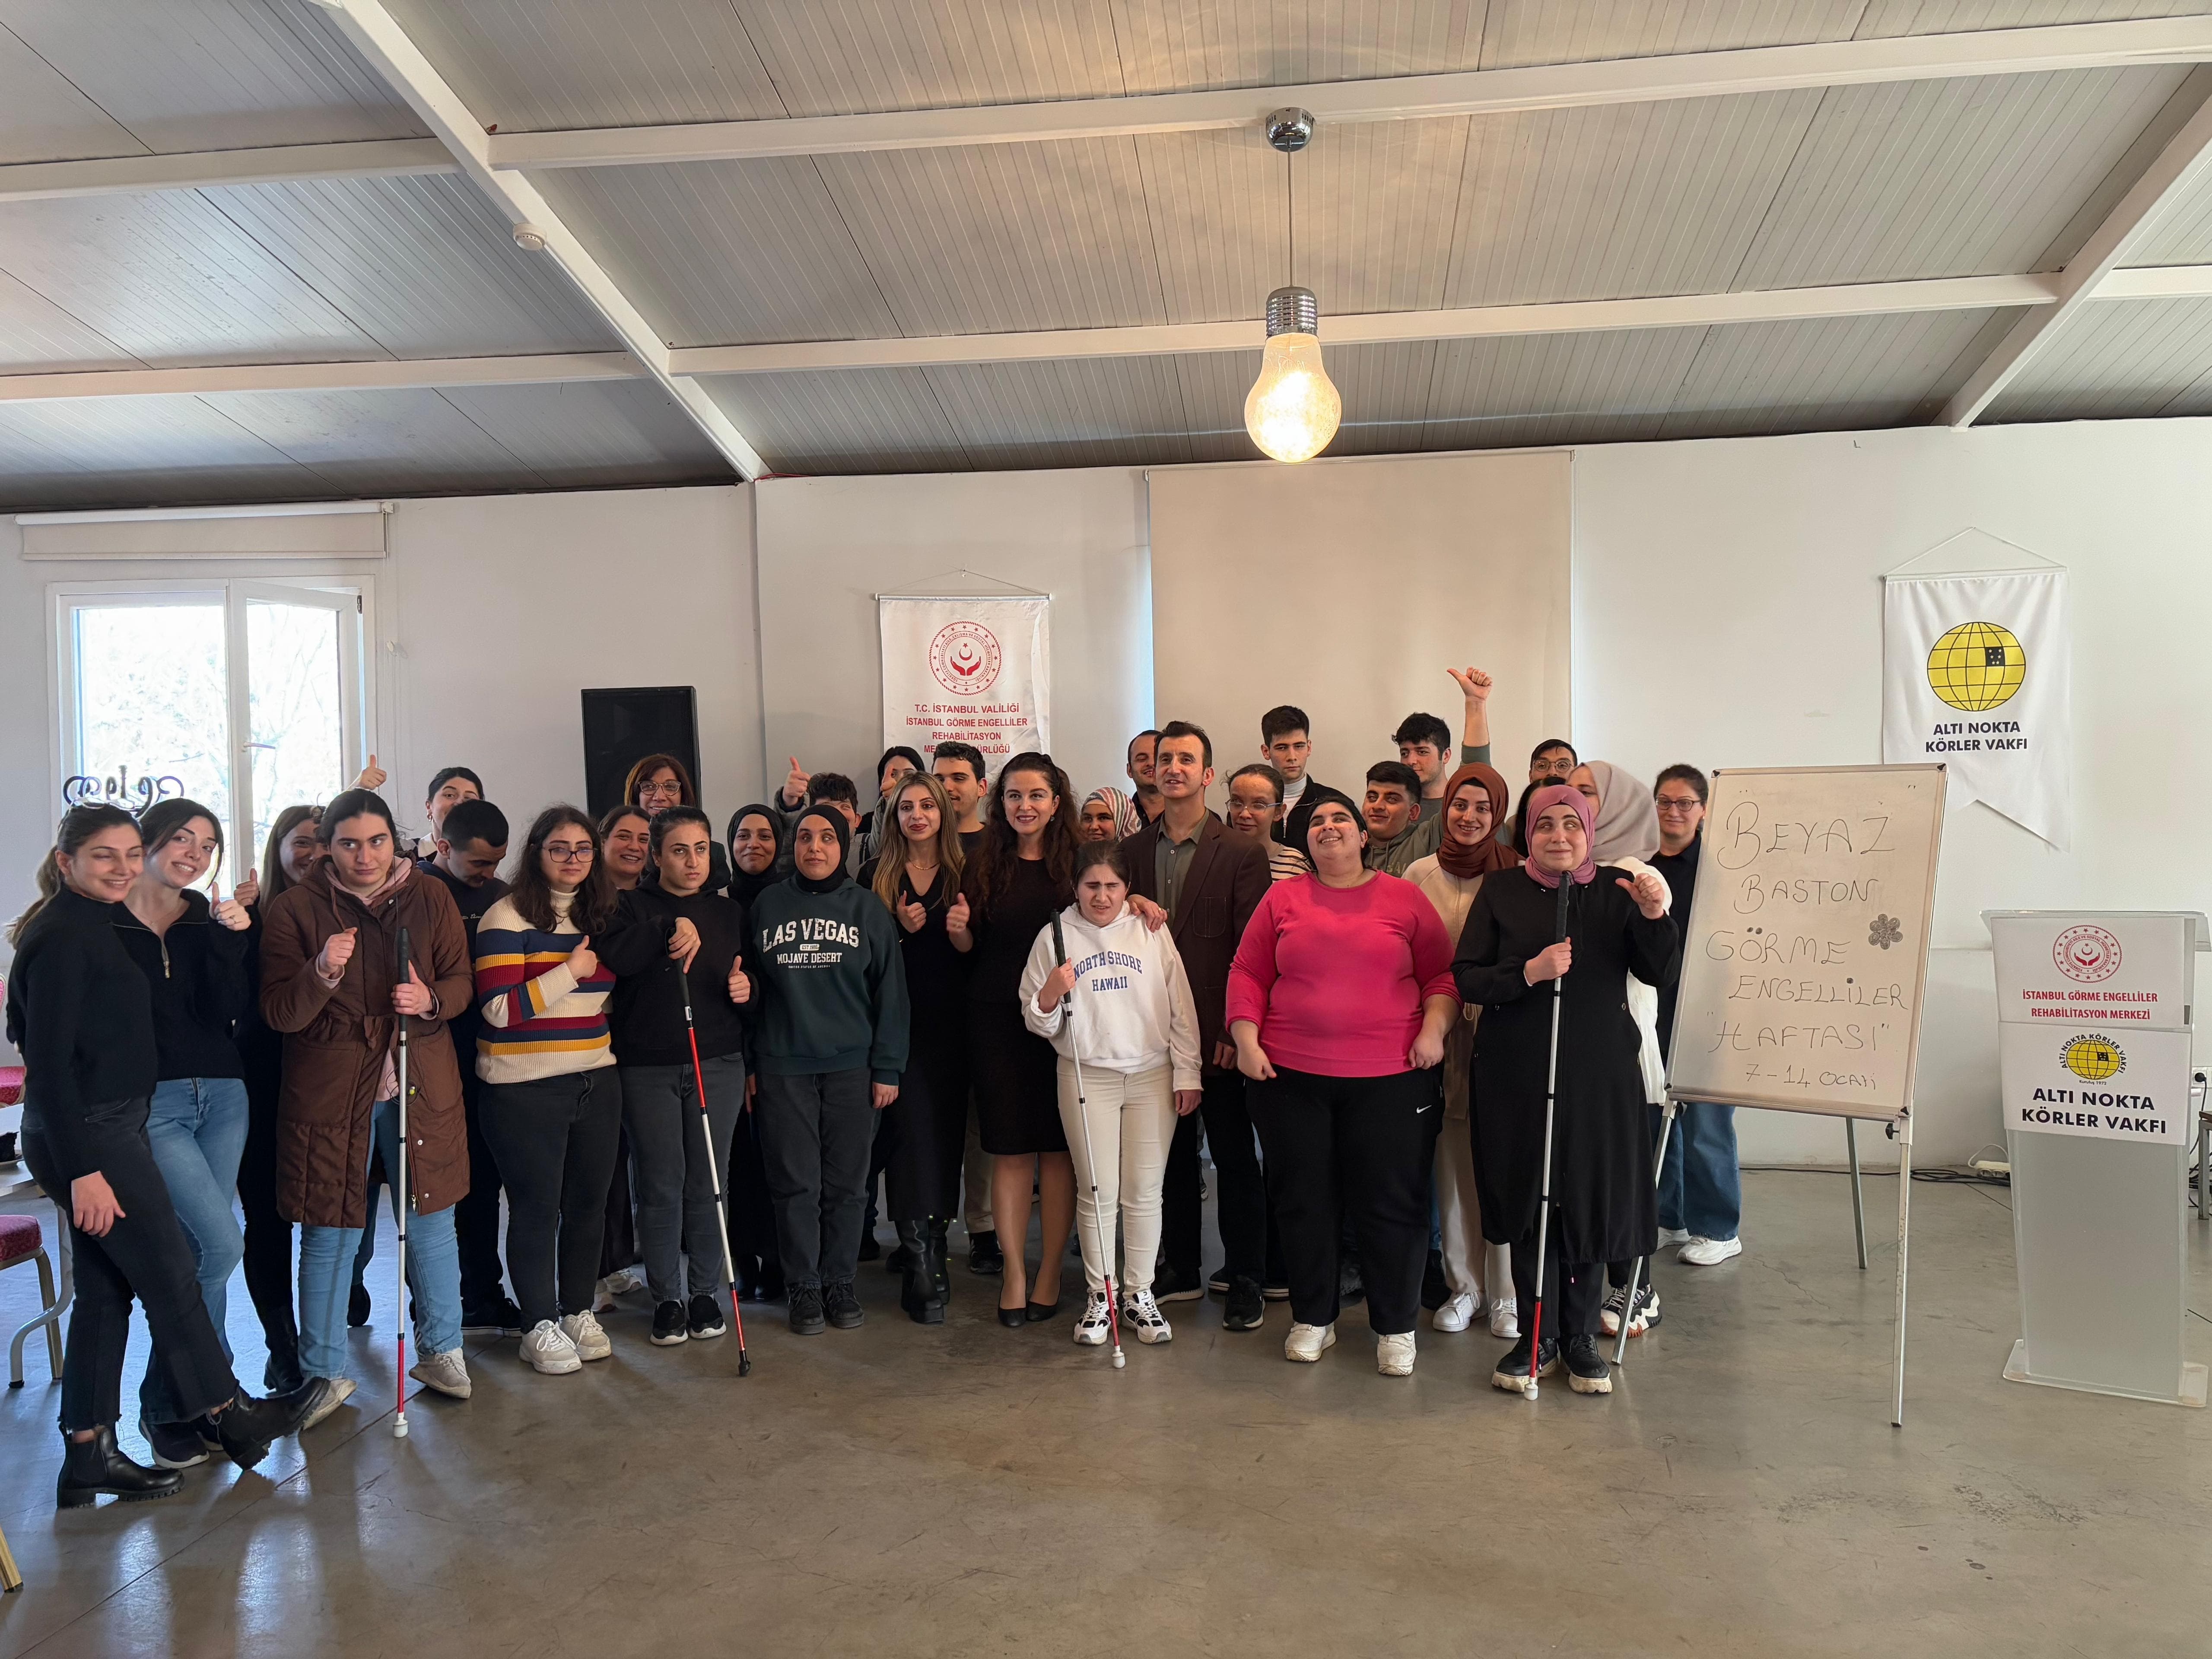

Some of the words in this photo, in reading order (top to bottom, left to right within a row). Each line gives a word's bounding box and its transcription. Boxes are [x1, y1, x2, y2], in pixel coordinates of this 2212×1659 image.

[915, 704, 930, 712] T.C.
[933, 703, 979, 713] İSTANBUL
[981, 703, 1019, 713] VALİLİĞİ
[906, 716, 944, 726] İSTANBUL
[947, 717, 976, 727] GÖRME
[978, 717, 1027, 726] ENGELLİLER
[1933, 723, 1963, 735] ALTI
[1968, 721, 2021, 734] NOKTA
[932, 731, 1001, 740] REHABİLİTASYON
[977, 744, 1010, 753] ÜRLÜĞÜ
[1926, 737, 1981, 752] KÖRLER
[1985, 738, 2027, 750] VAKFI
[1734, 874, 1879, 914] BASTON
[763, 921, 797, 953] LAS
[801, 918, 859, 948] VEGAS
[1706, 927, 1851, 964] GÖRME
[777, 953, 808, 964] MOJAVE
[811, 953, 842, 963] DESERT
[1074, 951, 1106, 982] NORTH
[1107, 950, 1142, 974] SHORE
[1092, 976, 1128, 992] HAWAII
[1729, 976, 1908, 1010] ENGELLİLER
[2023, 989, 2066, 1000] İSTANBUL
[2068, 990, 2101, 1001] GÖRME
[2103, 991, 2158, 1002] ENGELLİLER
[2031, 1007, 2107, 1019] REHABİLİTASYON
[2110, 1009, 2150, 1020] MERKEZİ
[2061, 1034, 2087, 1051] NOKTA
[2089, 1033, 2120, 1049] KÖRLER
[2059, 1053, 2068, 1068] ALTI
[2118, 1050, 2126, 1074] VAKFI
[2033, 1088, 2073, 1103] ALTI
[2082, 1092, 2155, 1110] NOKTA
[2022, 1106, 2098, 1128] KÖRLER
[2105, 1116, 2166, 1134] VAKFI
